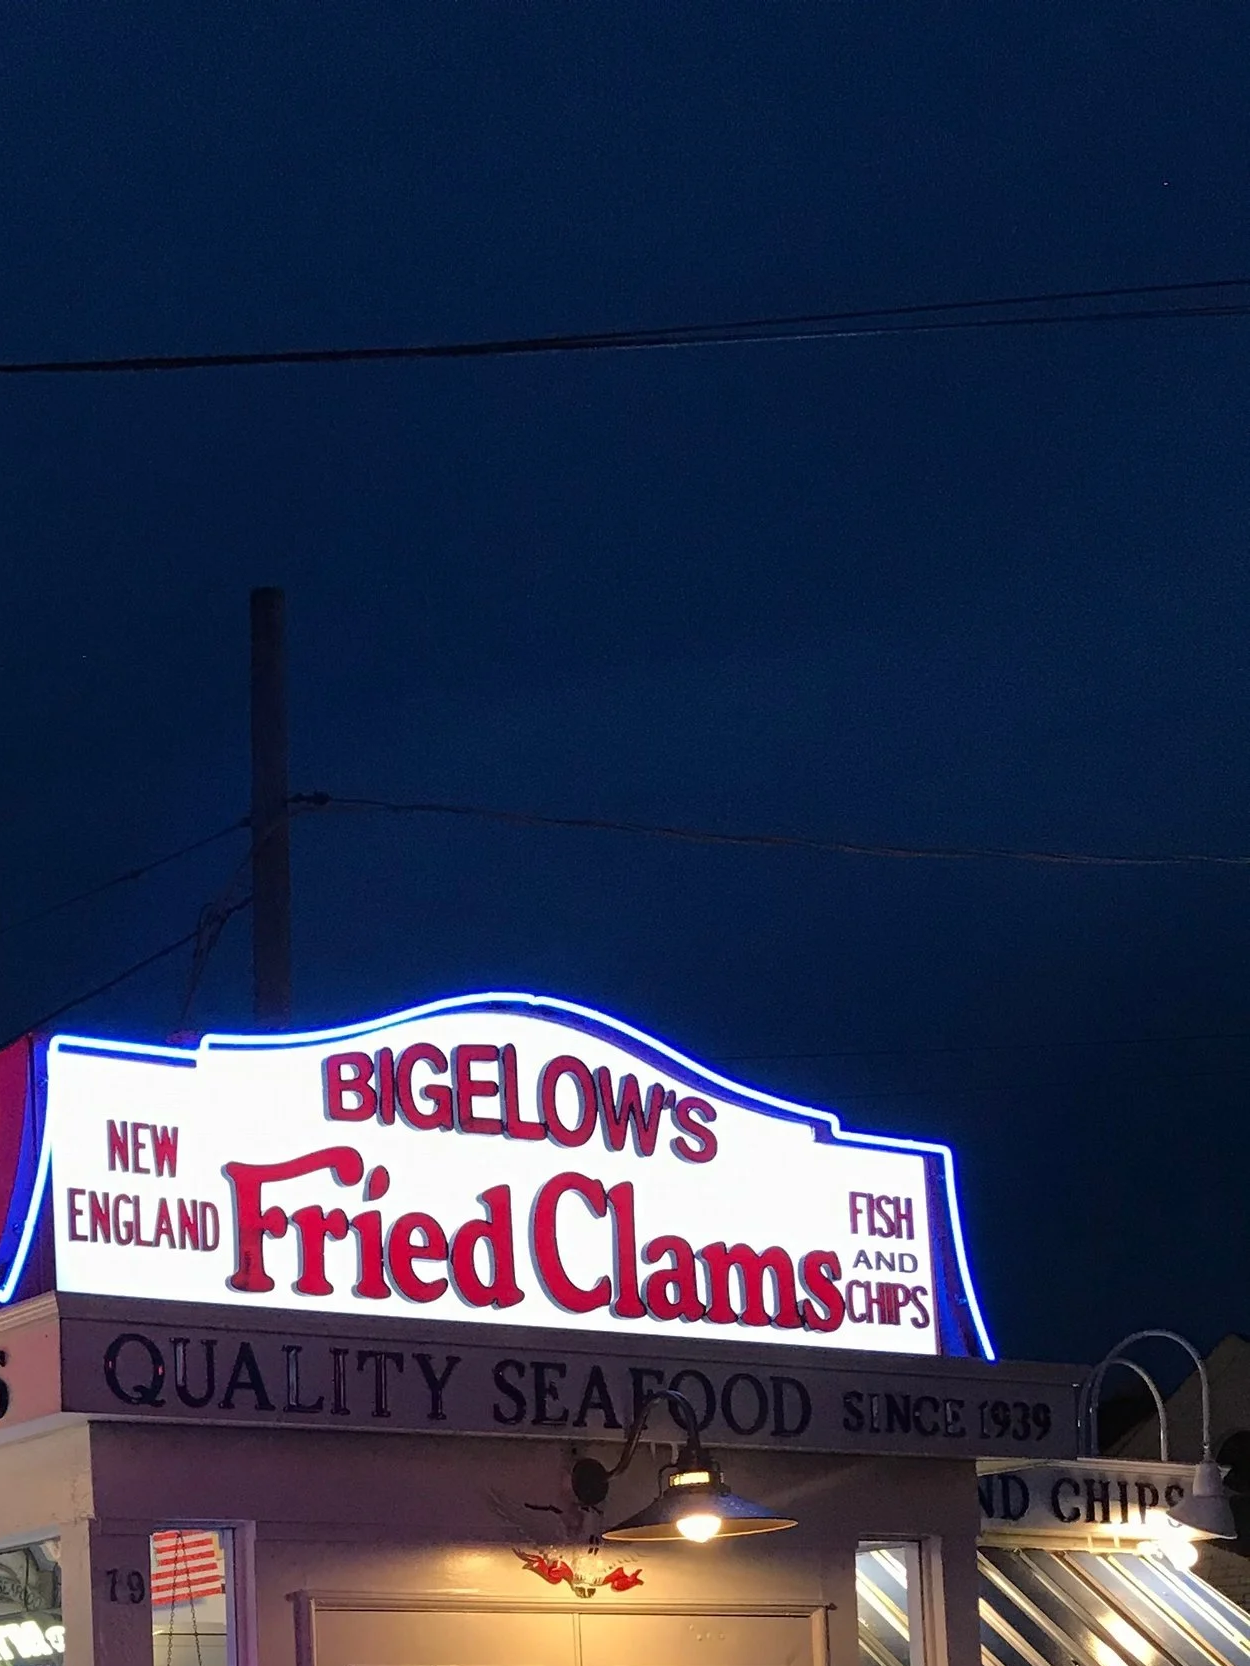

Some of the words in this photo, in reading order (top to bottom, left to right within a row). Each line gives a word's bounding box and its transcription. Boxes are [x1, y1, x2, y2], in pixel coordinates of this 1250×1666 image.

[323, 1042, 718, 1164] BIGELOW'S
[106, 1119, 179, 1178] NEW
[67, 1187, 220, 1252] ENGLAND
[222, 1146, 525, 1309] Fried
[530, 1171, 845, 1332] Clams
[849, 1191, 914, 1240] FISH
[852, 1249, 918, 1273] AND
[845, 1279, 930, 1329] CHIPS
[104, 1333, 462, 1420] QUALITY
[492, 1358, 812, 1437] SEAFOOD
[842, 1390, 966, 1438] SINCE
[978, 1400, 1052, 1441] 1939
[978, 1474, 1030, 1521] ND
